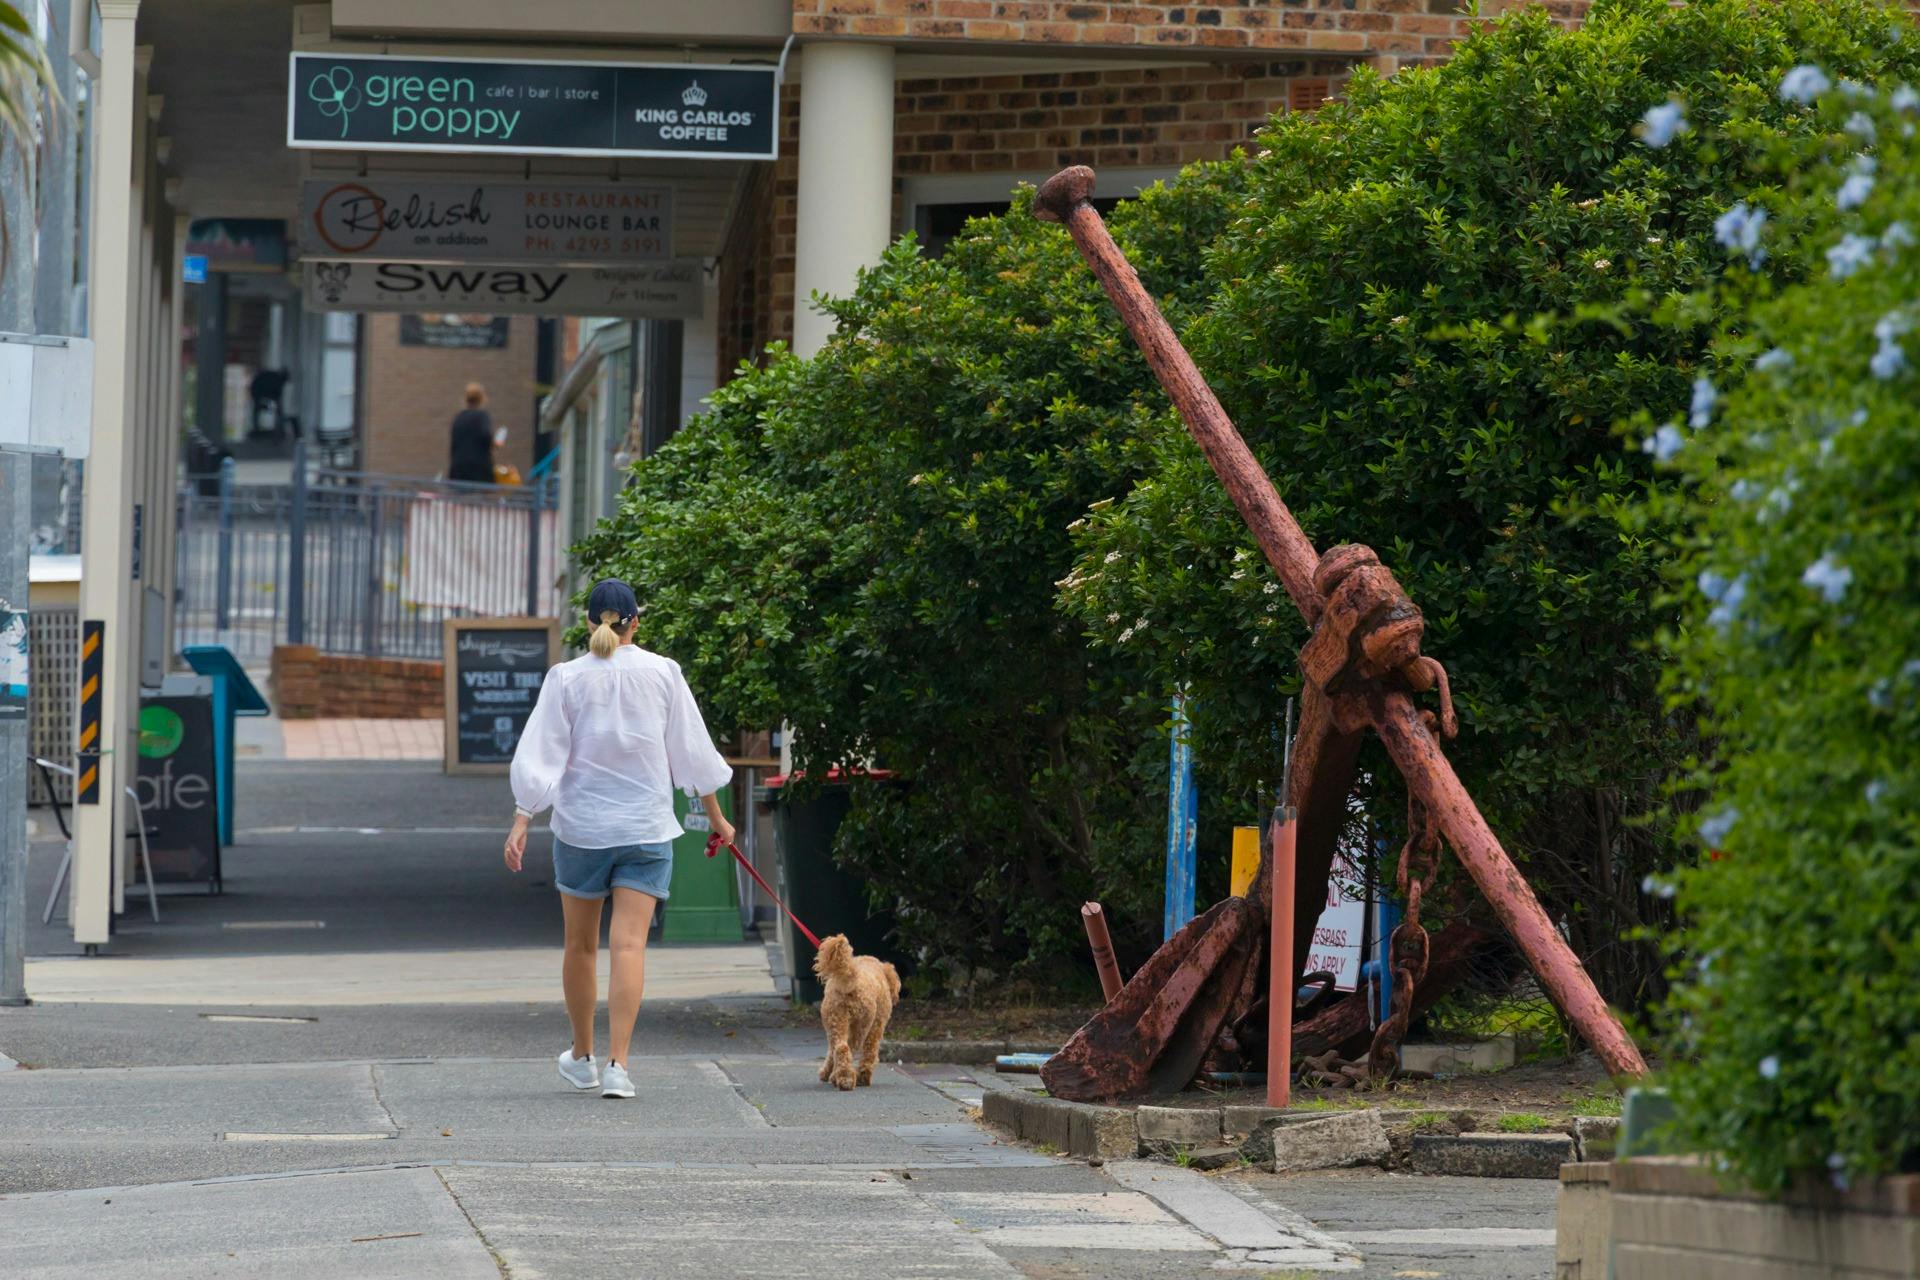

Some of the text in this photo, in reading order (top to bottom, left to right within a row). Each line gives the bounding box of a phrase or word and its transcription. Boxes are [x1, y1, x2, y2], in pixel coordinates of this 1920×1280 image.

[365, 75, 475, 107] green
[486, 86, 599, 100] cafe bar store
[392, 107, 521, 139] poppy
[635, 109, 752, 126] KING CARLOS
[658, 126, 728, 141] COFFEE
[524, 192, 662, 209] RESTAURANT
[341, 188, 491, 233] Relish
[525, 214, 661, 231] LOUNGE BAR
[414, 232, 488, 246] on addison
[525, 236, 662, 253] PH: 4295 5191
[375, 263, 568, 303] Sway
[463, 671, 508, 688] VISIT
[137, 758, 210, 810] afe
[1312, 927, 1348, 948] ESPASS
[1321, 956, 1347, 975] APPLY
